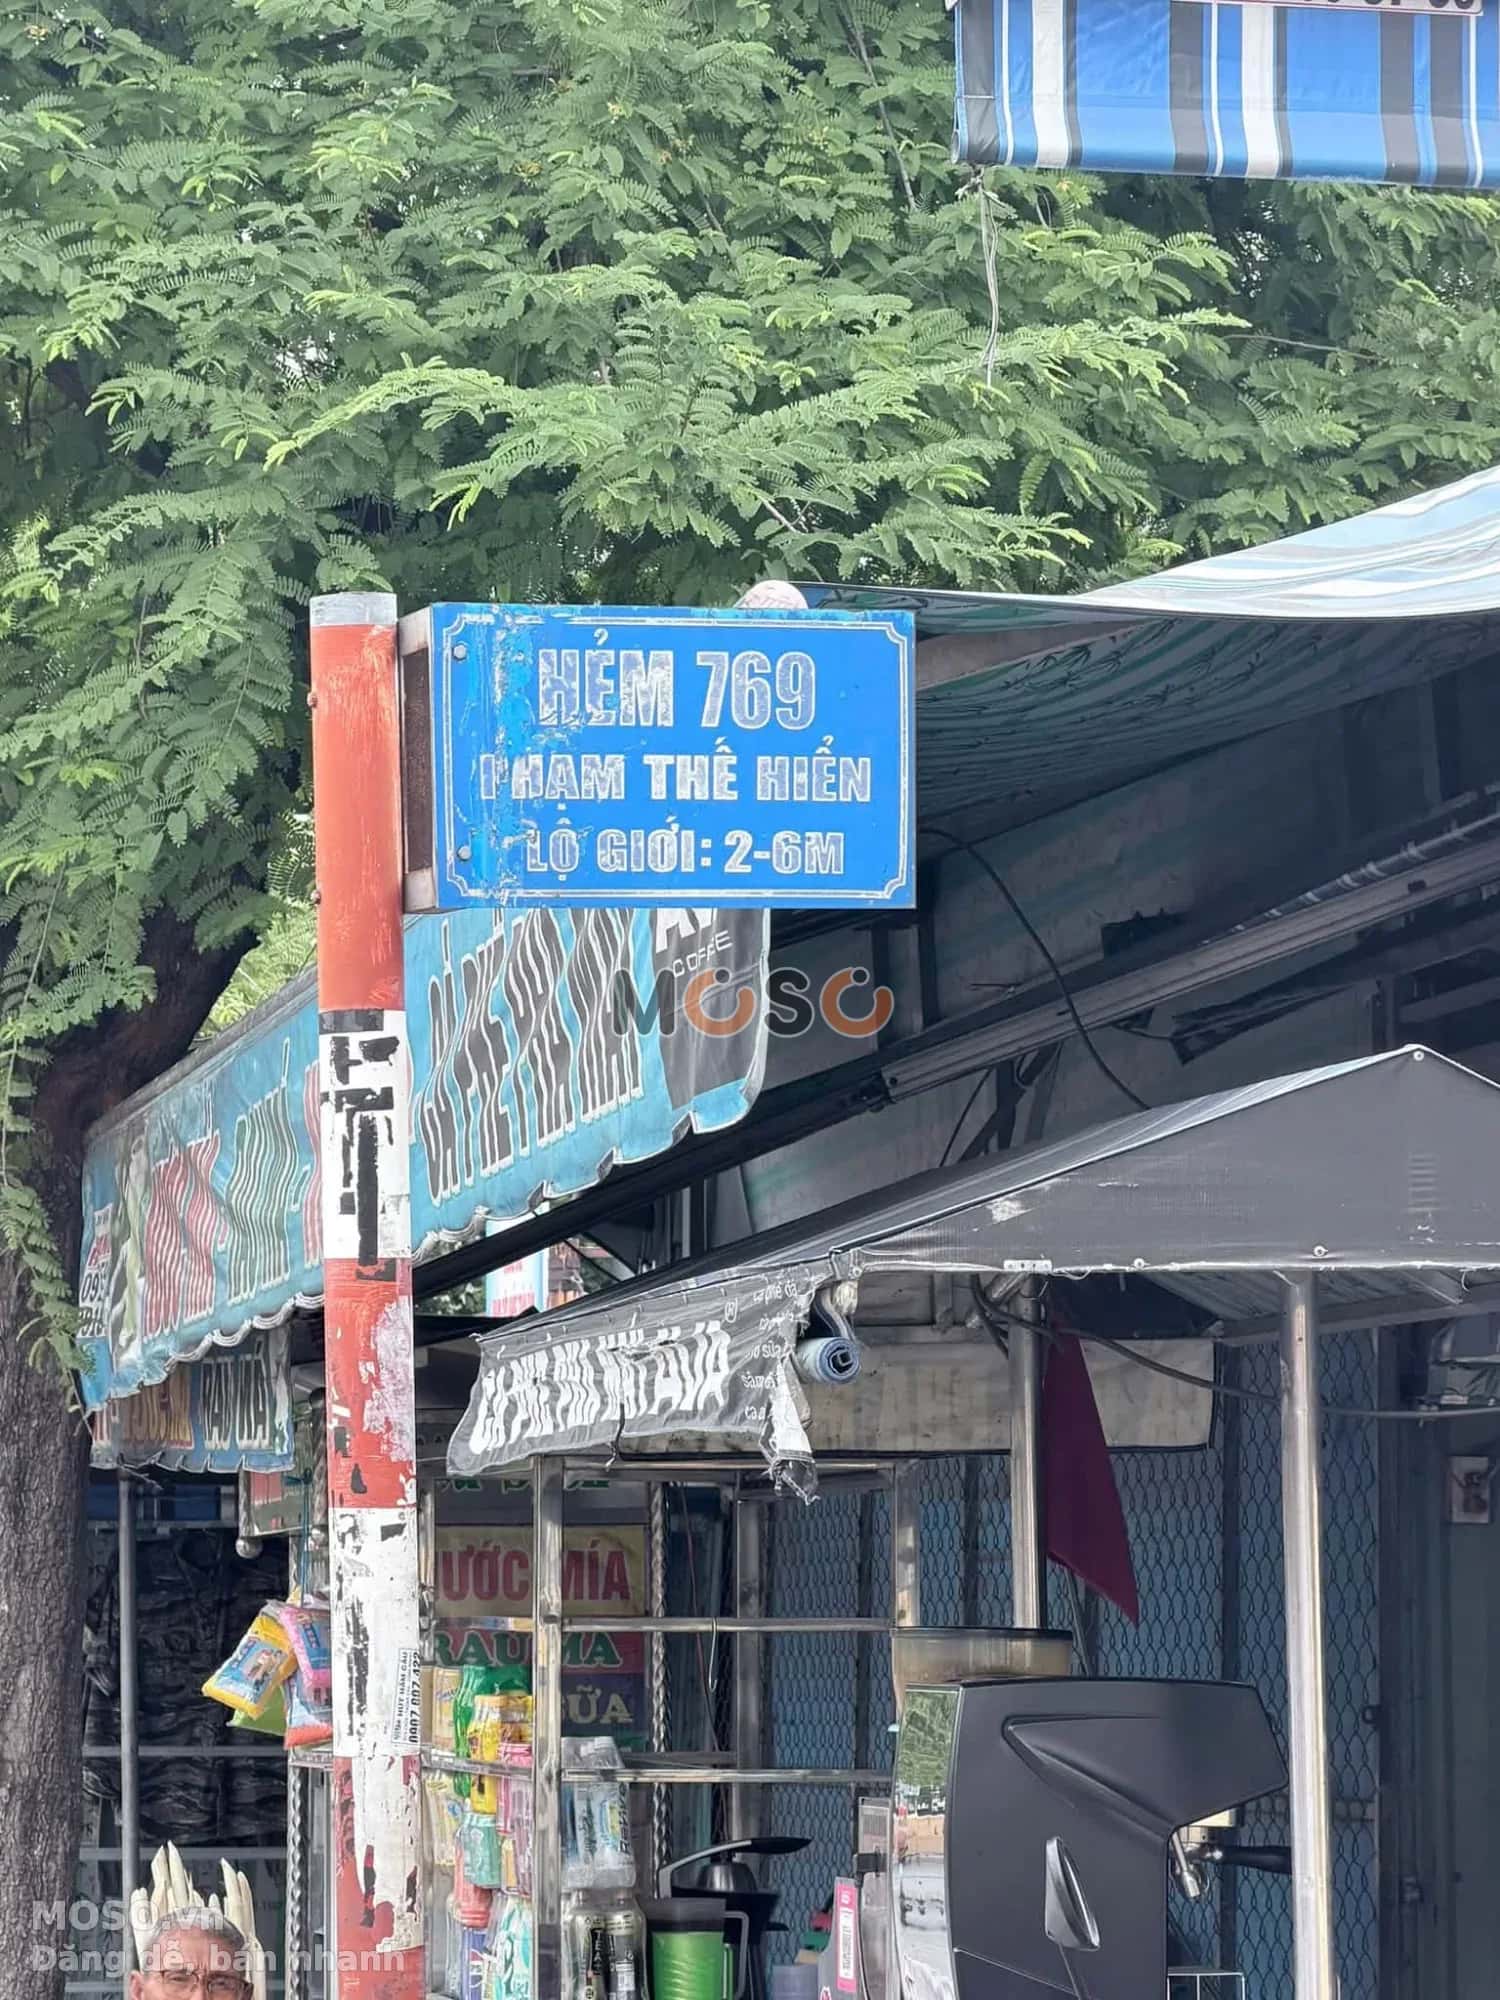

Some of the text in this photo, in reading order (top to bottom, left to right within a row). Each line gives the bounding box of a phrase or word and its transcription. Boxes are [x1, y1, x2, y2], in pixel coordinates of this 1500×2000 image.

[539, 628, 815, 730] HẺM 769
[643, 737, 739, 800] THẾ
[756, 736, 871, 802] HIỂN
[527, 817, 580, 881] LỘ
[724, 830, 845, 874] 2-6M
[435, 1540, 529, 1602] ƯỚC
[567, 1684, 634, 1724] ỮA
